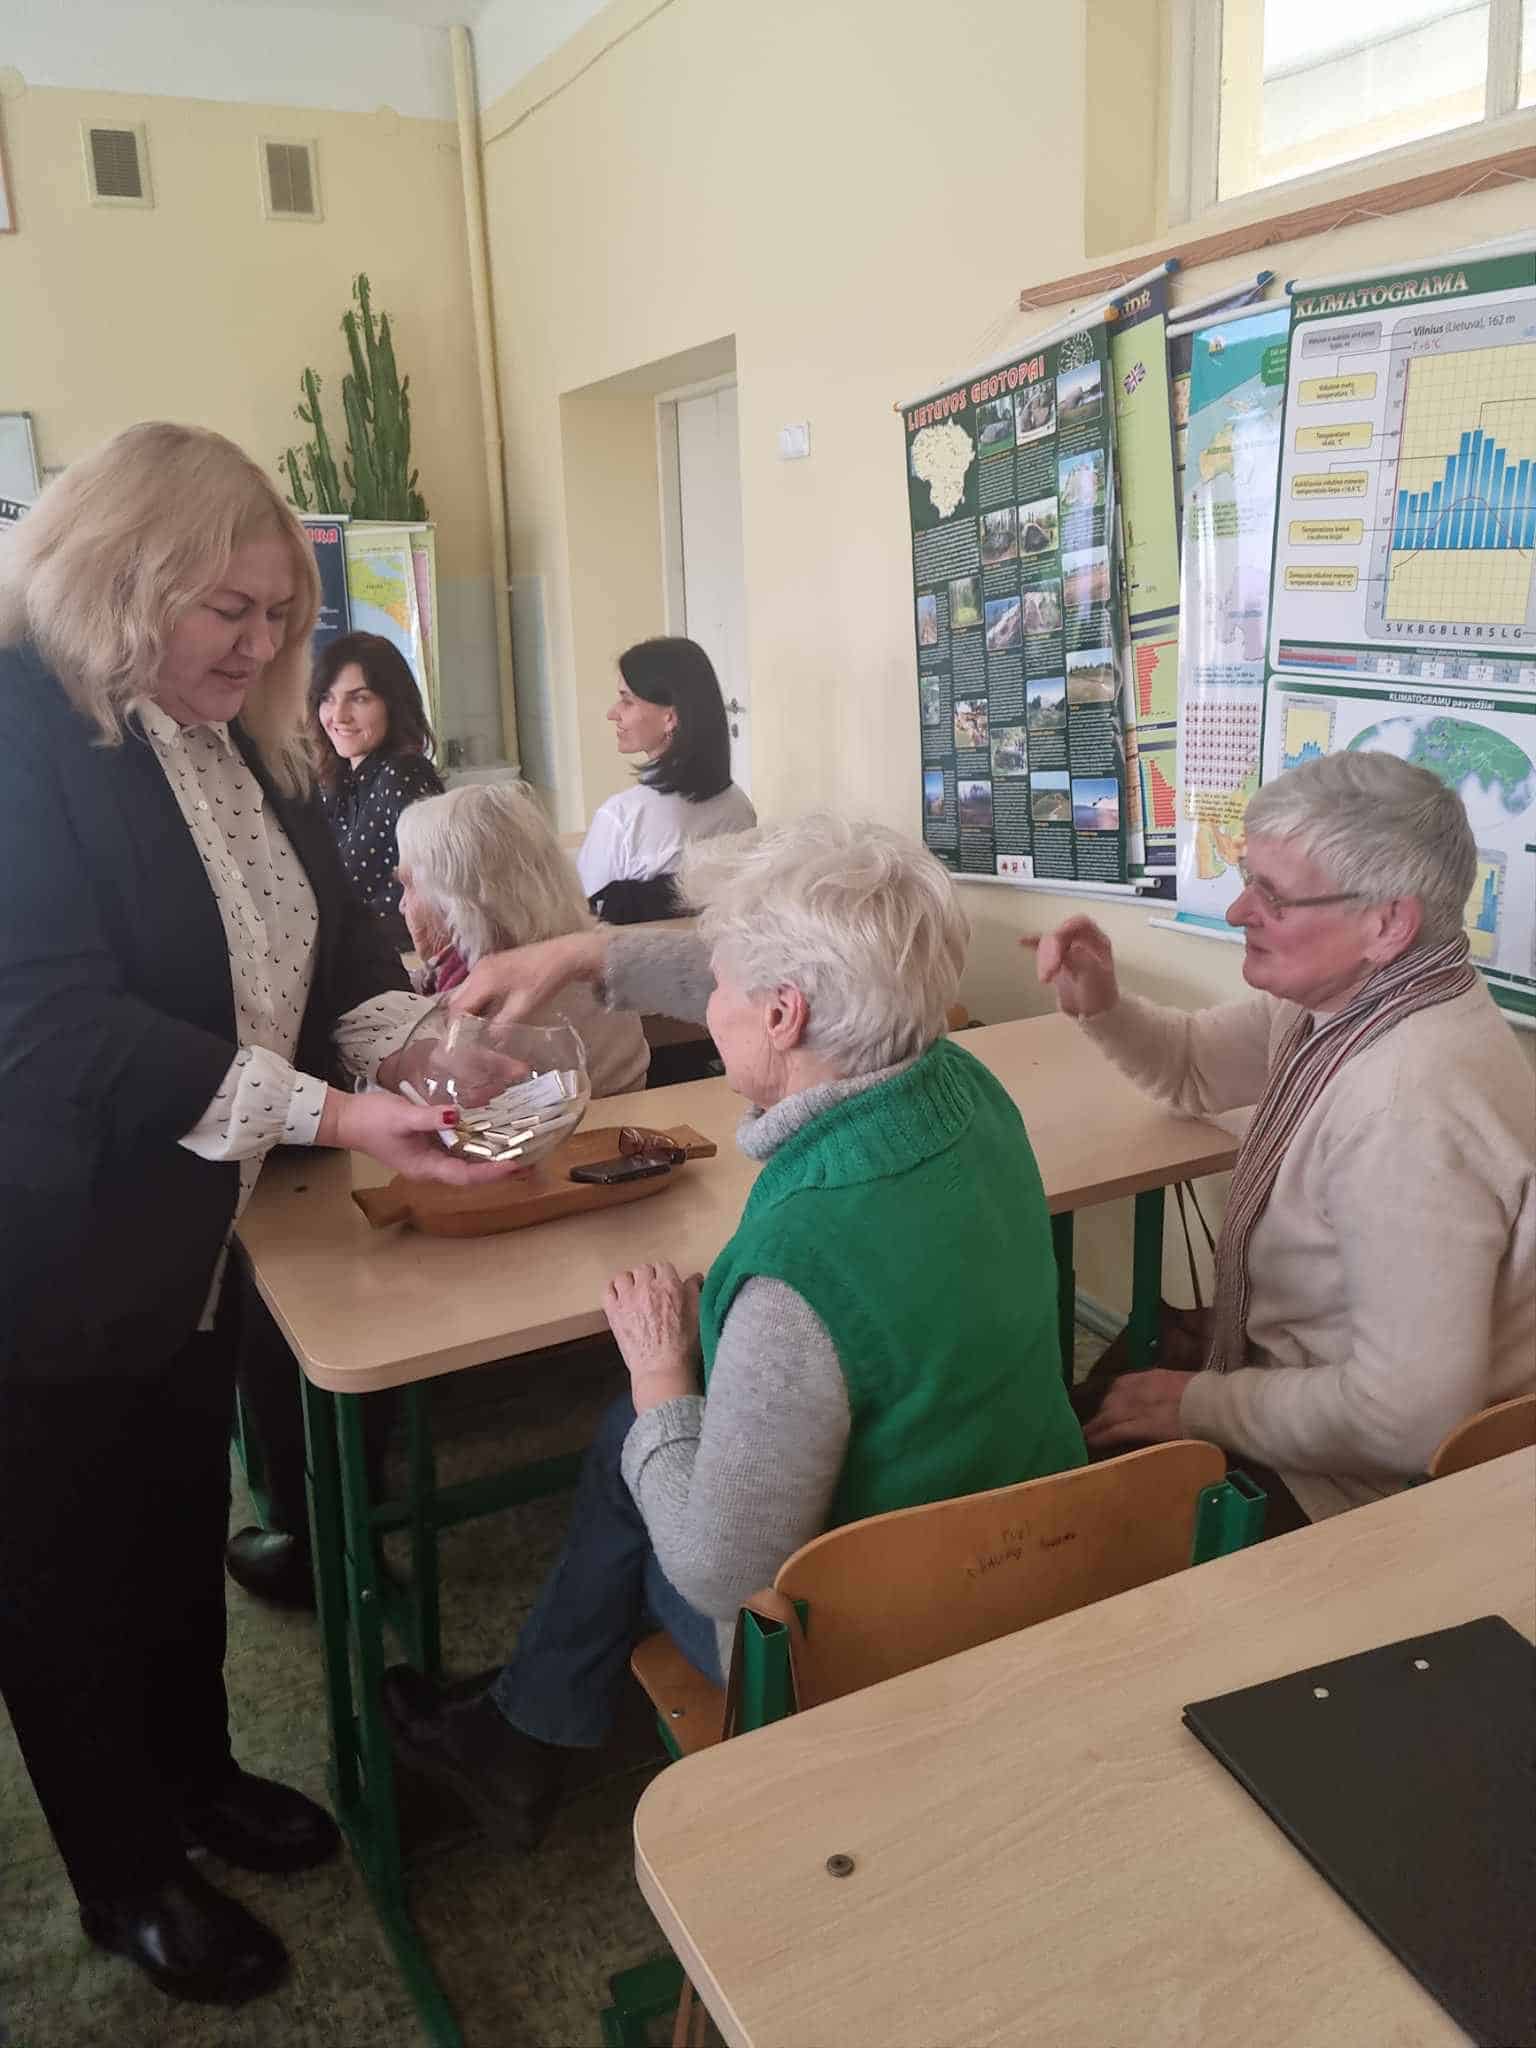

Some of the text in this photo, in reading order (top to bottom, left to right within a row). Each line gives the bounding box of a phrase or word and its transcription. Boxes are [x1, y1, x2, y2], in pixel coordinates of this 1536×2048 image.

[1294, 271, 1469, 319] KLIMATOGRAMA
[1413, 324, 1444, 337] Vilnius
[908, 355, 1045, 432] LIETUVOS GEOTOPAI
[1385, 623, 1521, 638] S V K B G B L R R S L G
